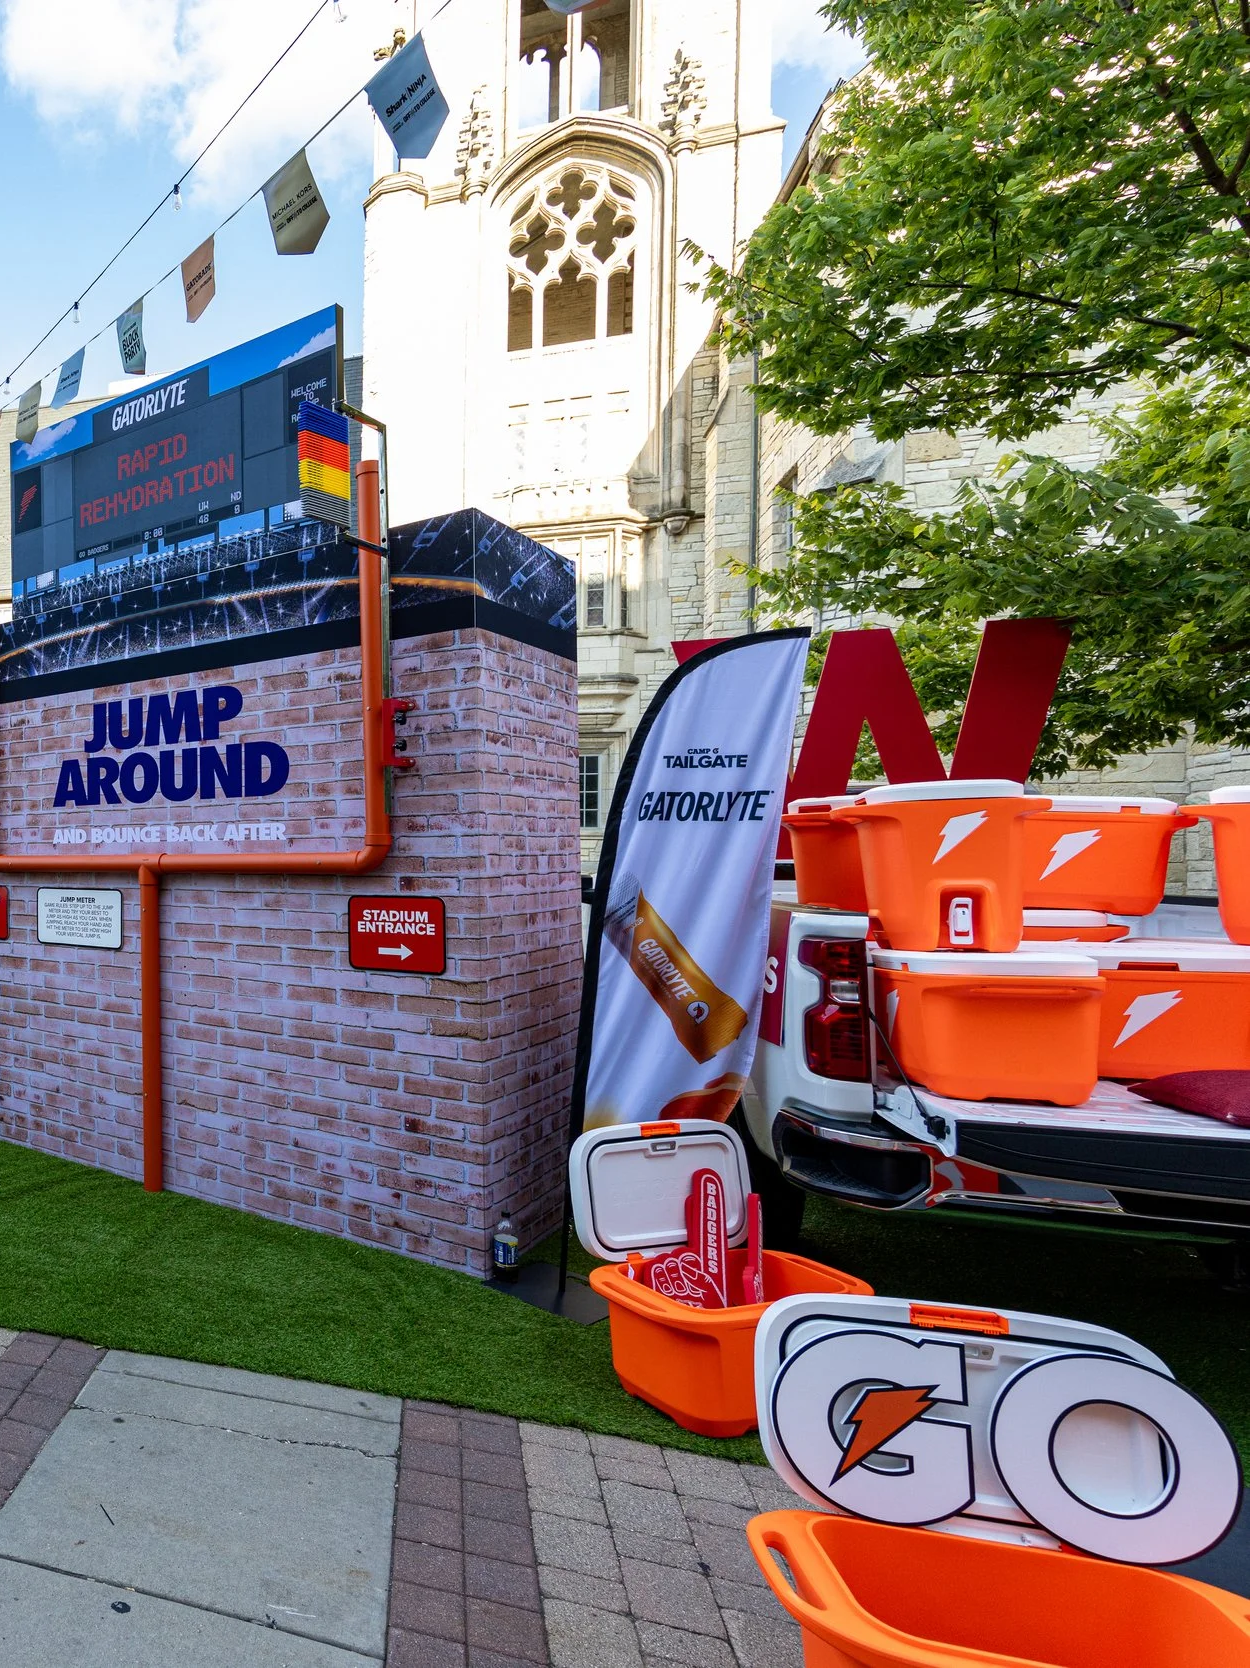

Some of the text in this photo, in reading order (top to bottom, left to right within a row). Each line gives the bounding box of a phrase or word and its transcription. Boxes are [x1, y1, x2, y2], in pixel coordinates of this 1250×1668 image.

[271, 183, 313, 220] MICHAEL KORS
[121, 326, 139, 351] BLOCK
[123, 338, 141, 364] PARTY
[290, 377, 327, 399] WELCOME
[304, 391, 314, 401] TO
[111, 378, 189, 431] GATORLYTE
[117, 432, 188, 481] RAPID
[79, 453, 235, 529] REHYDRATION
[198, 490, 242, 512] UW ND
[87, 543, 109, 556] BADGERS
[83, 685, 243, 754] JUMP
[52, 740, 290, 808] AROUND
[663, 754, 748, 769] TAILGATE
[638, 790, 774, 822] GATORLYTE
[53, 822, 288, 845] AND BOUNCE BACK AFTER
[357, 920, 436, 935] ENTRANCE
[362, 909, 429, 923] STADIUM
[637, 938, 699, 1000] GATORLYTE
[706, 1182, 718, 1275] BADGERS
